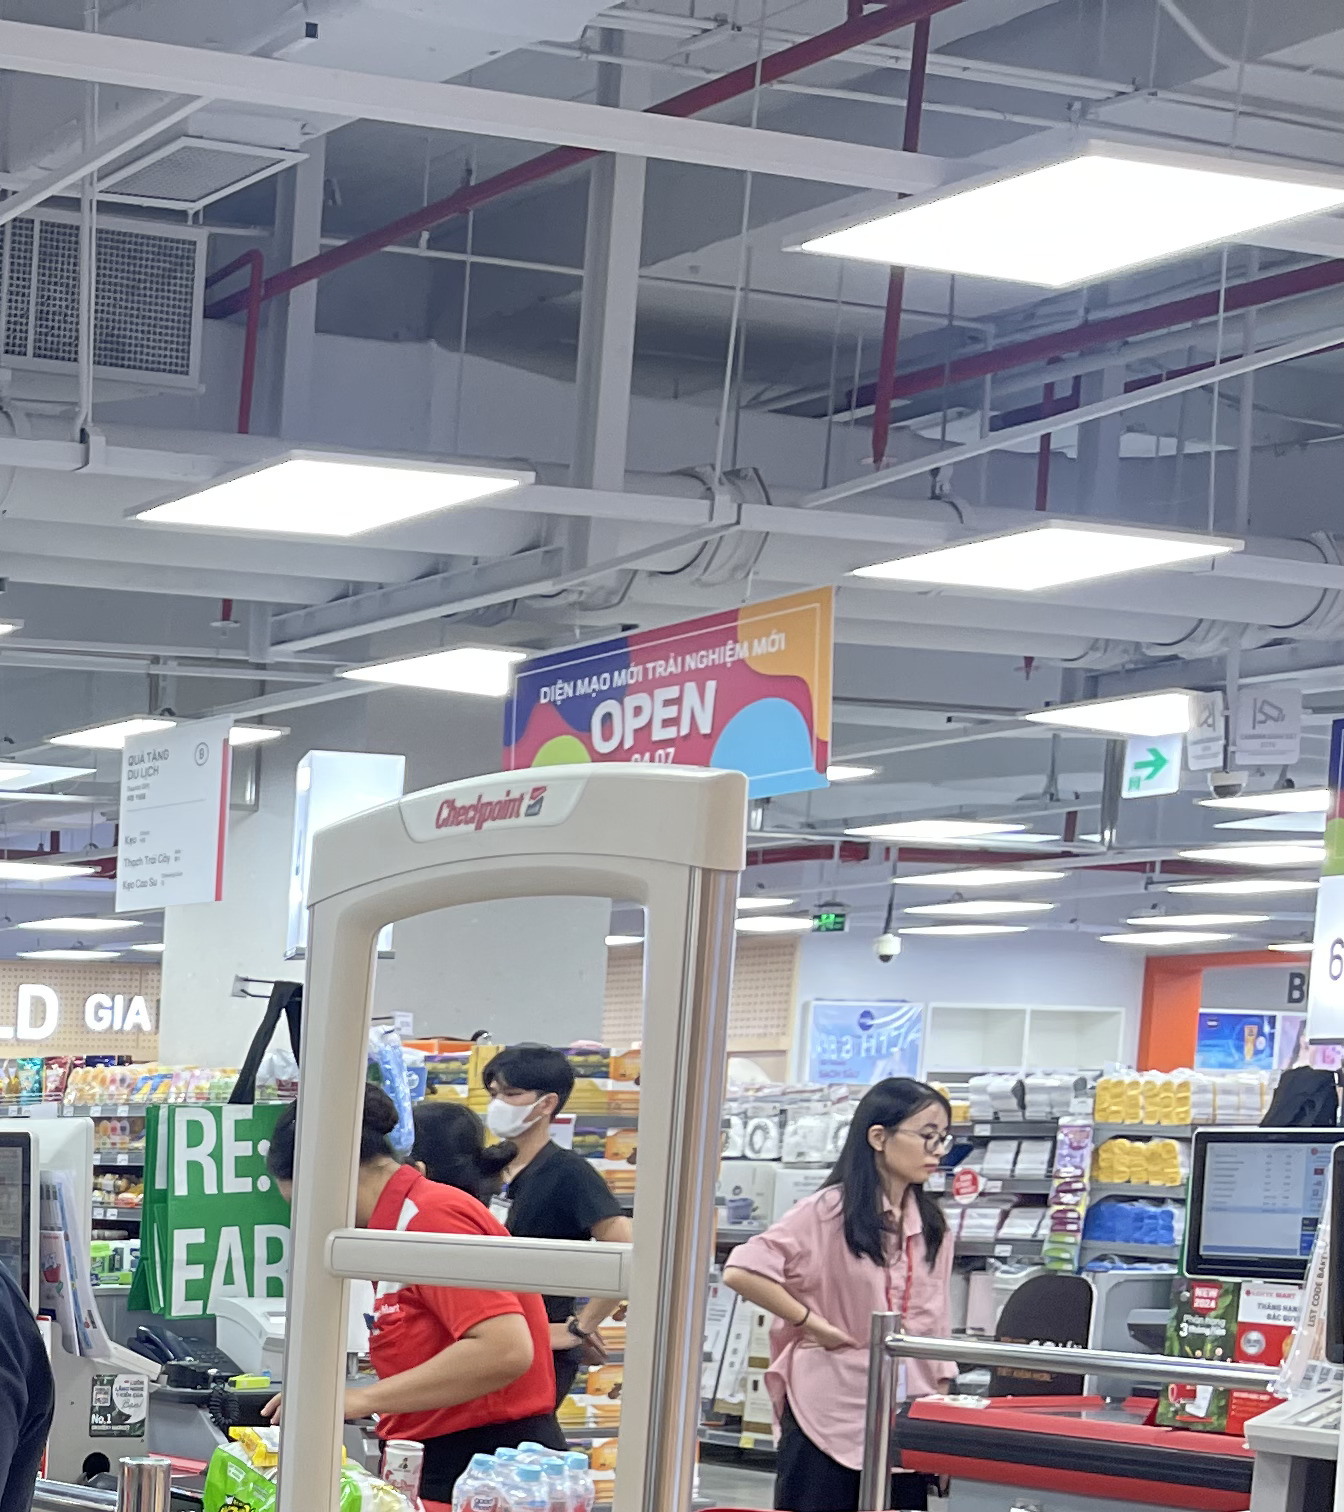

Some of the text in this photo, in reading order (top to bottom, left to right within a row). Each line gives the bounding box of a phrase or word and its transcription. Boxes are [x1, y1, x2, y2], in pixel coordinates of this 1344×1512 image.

[540, 680, 574, 705] DIỆN
[575, 673, 611, 698] MẠO
[613, 663, 643, 688] MỚI
[685, 640, 749, 672] NGHIỆM
[752, 629, 786, 656] MỚI
[590, 680, 717, 754] OPEN
[435, 791, 524, 832] Checkpoint
[1328, 937, 1344, 982] 6
[85, 993, 152, 1032] GIA
[173, 1104, 271, 1196] RE:
[91, 1413, 111, 1424] No.1
